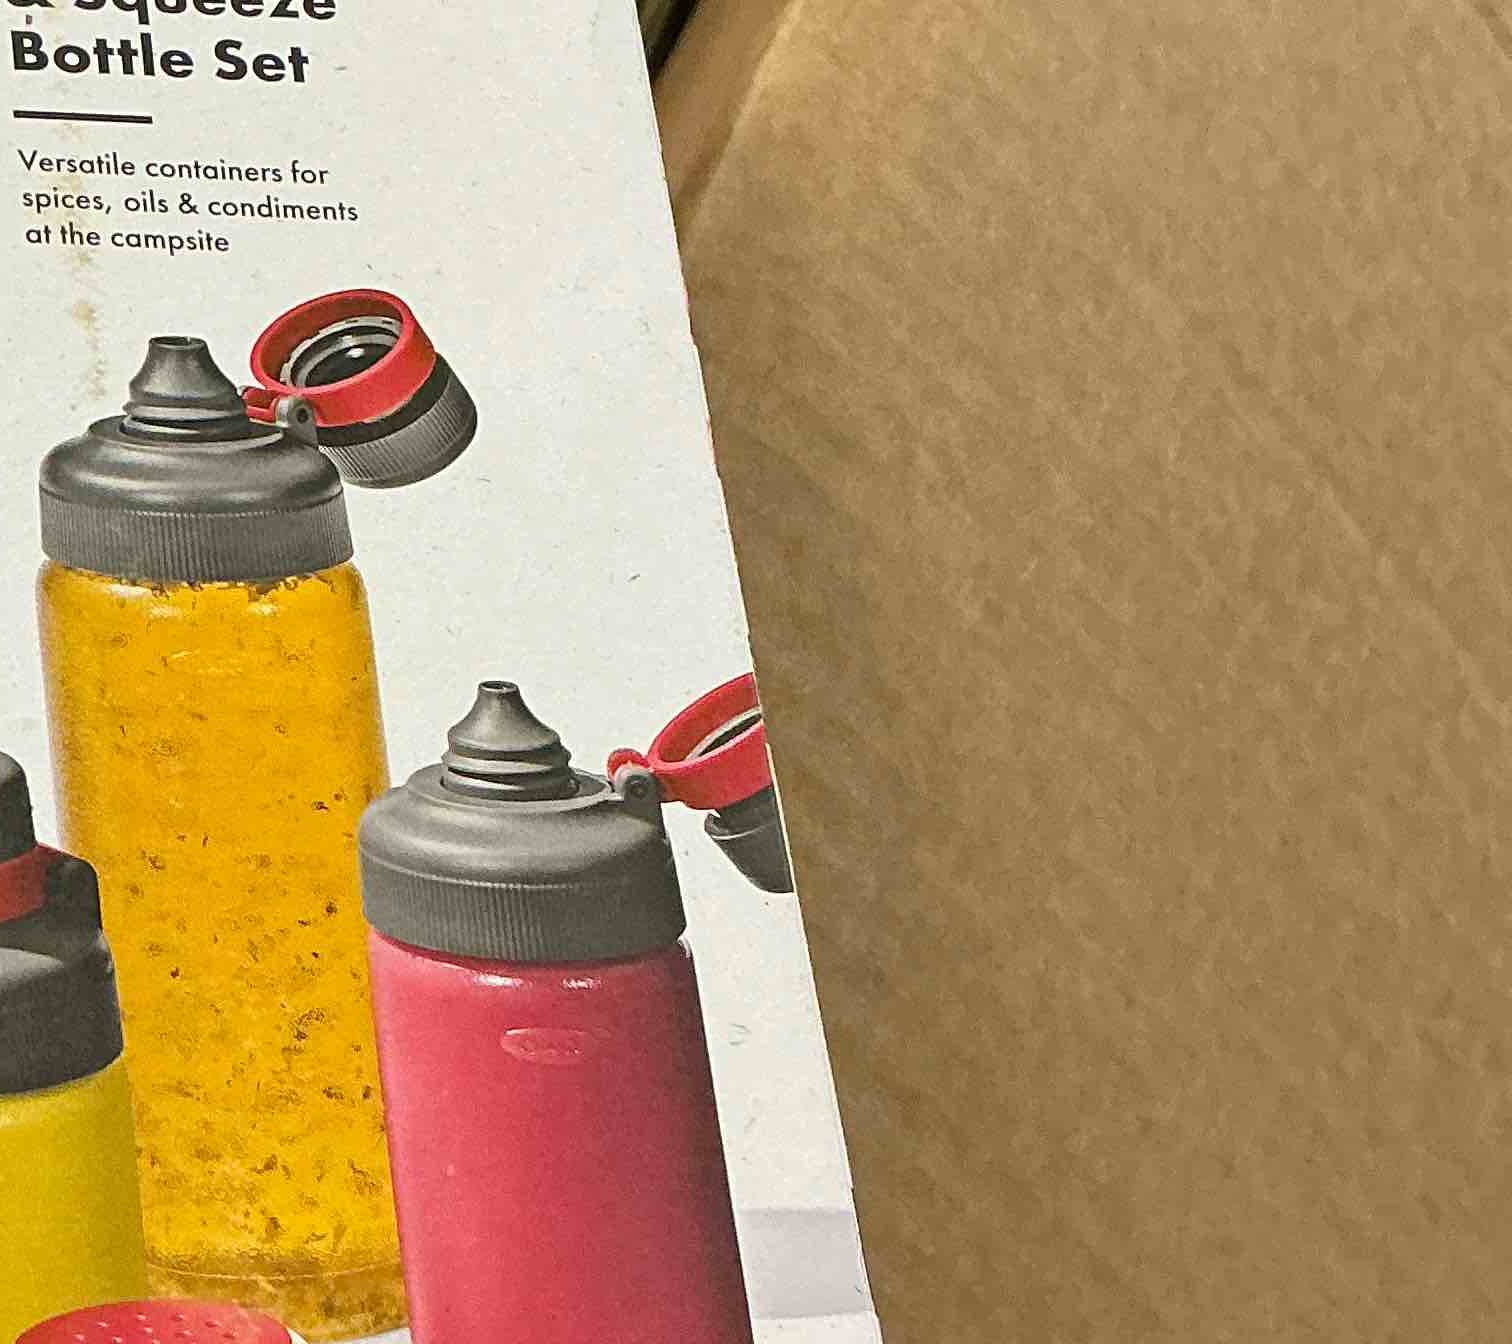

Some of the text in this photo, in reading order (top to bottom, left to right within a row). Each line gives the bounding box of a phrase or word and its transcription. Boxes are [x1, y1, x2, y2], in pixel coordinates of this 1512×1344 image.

[11, 30, 309, 82] Bottle Set
[18, 150, 328, 184] Versatile containers for
[23, 187, 358, 221] spices, oils & condiments
[26, 222, 229, 256] at the campsite
